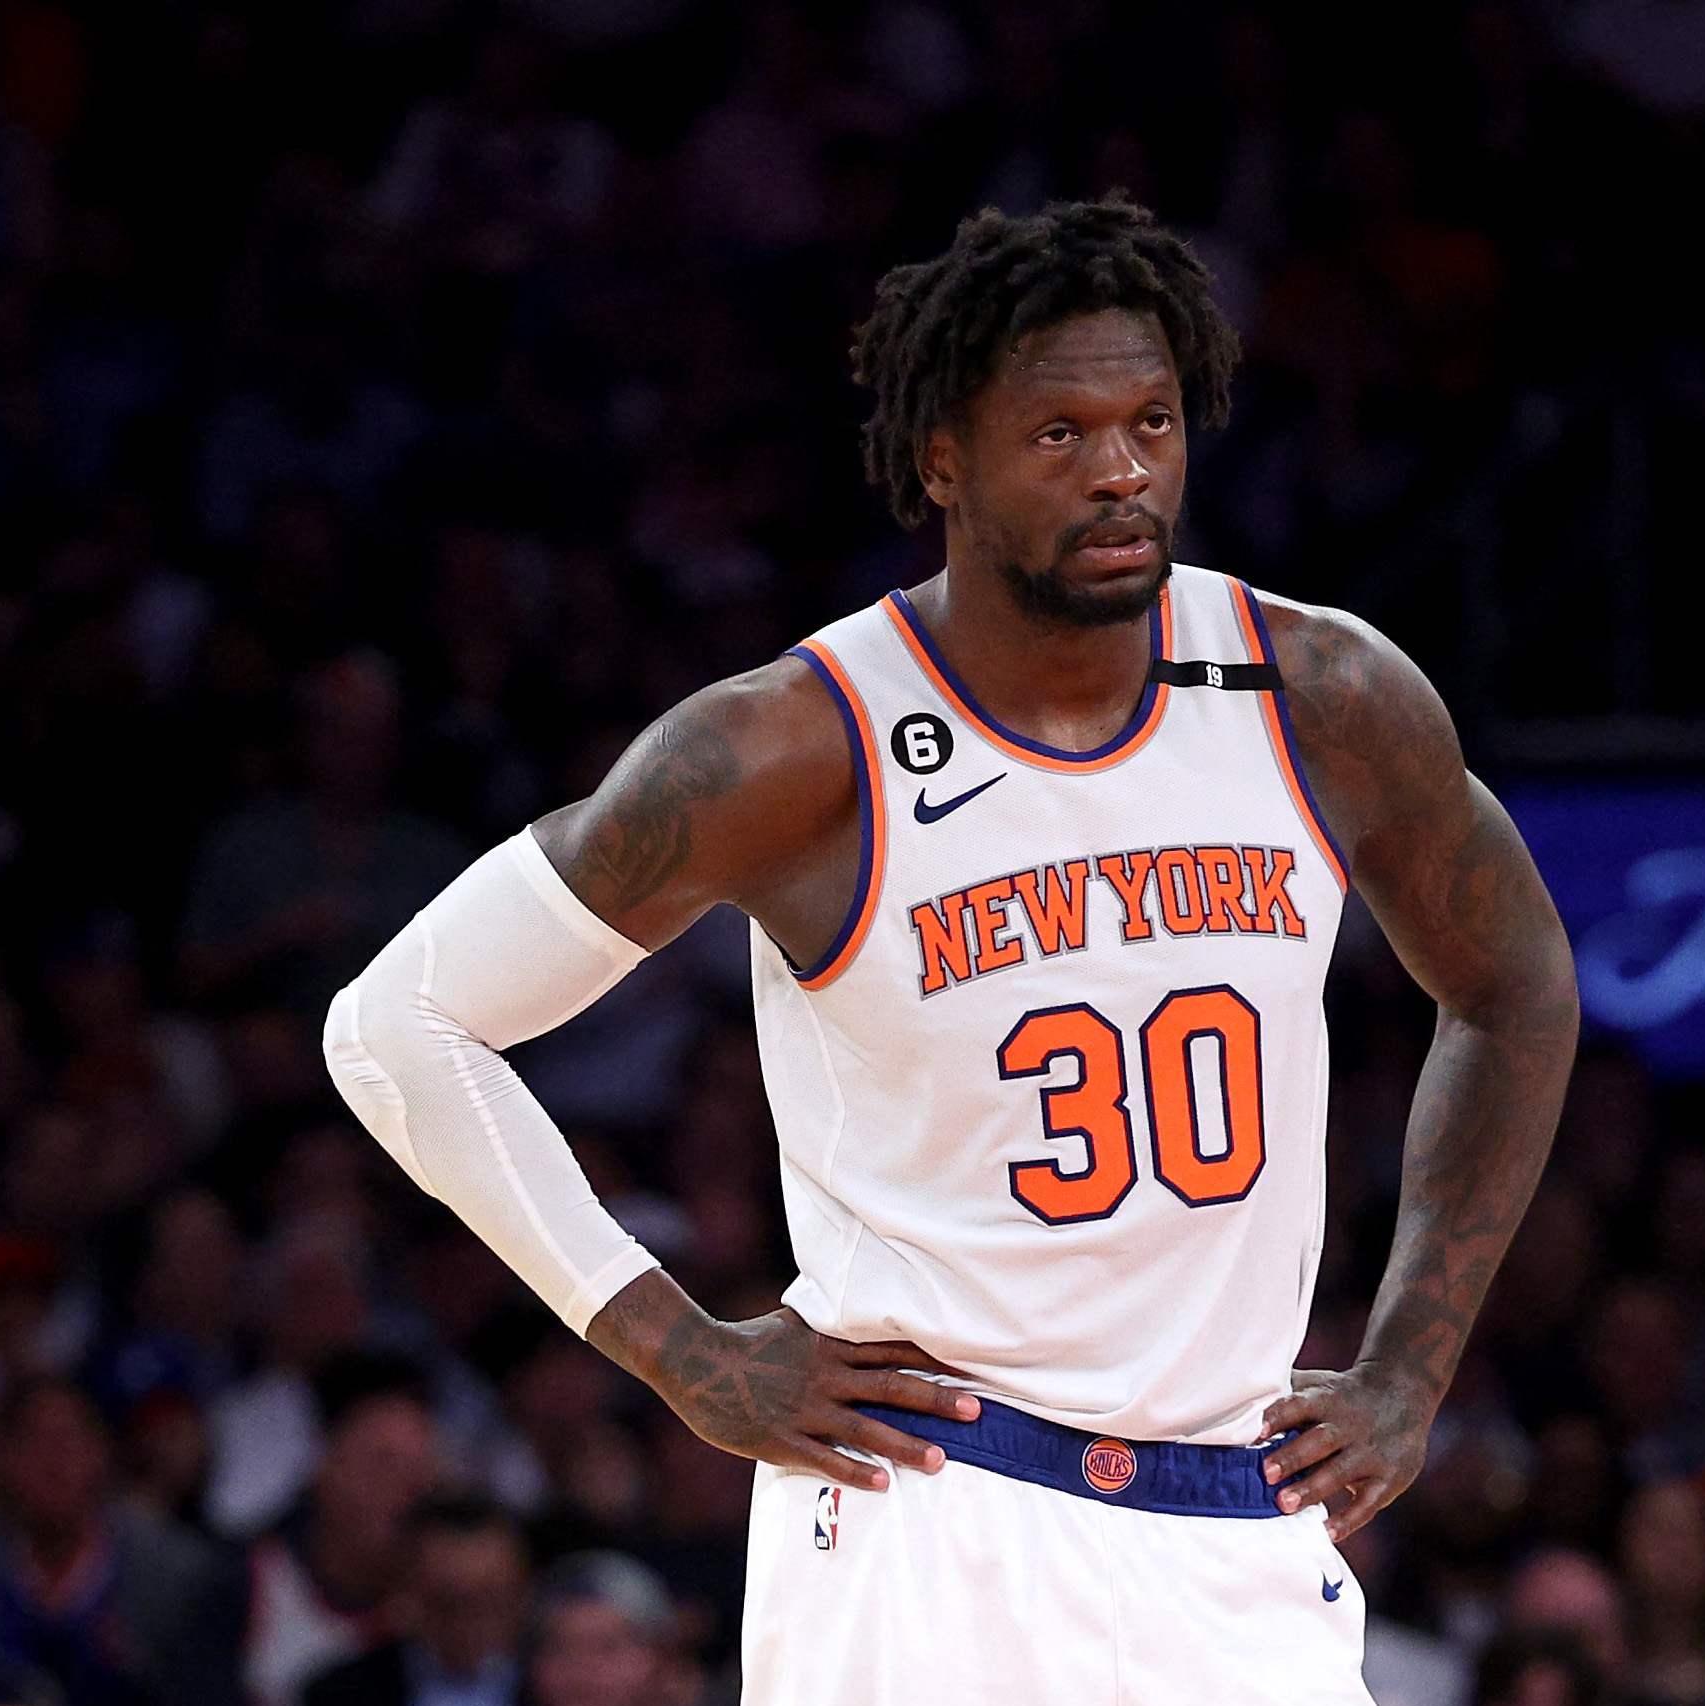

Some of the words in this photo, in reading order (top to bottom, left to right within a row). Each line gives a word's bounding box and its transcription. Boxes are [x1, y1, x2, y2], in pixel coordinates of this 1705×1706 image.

[1205, 663, 1223, 688] 19
[903, 721, 941, 768] 6
[906, 856, 1093, 999] NEW
[1096, 843, 1308, 945] YORK
[996, 983, 1267, 1226] 30
[1089, 1451, 1131, 1478] KNICKS
